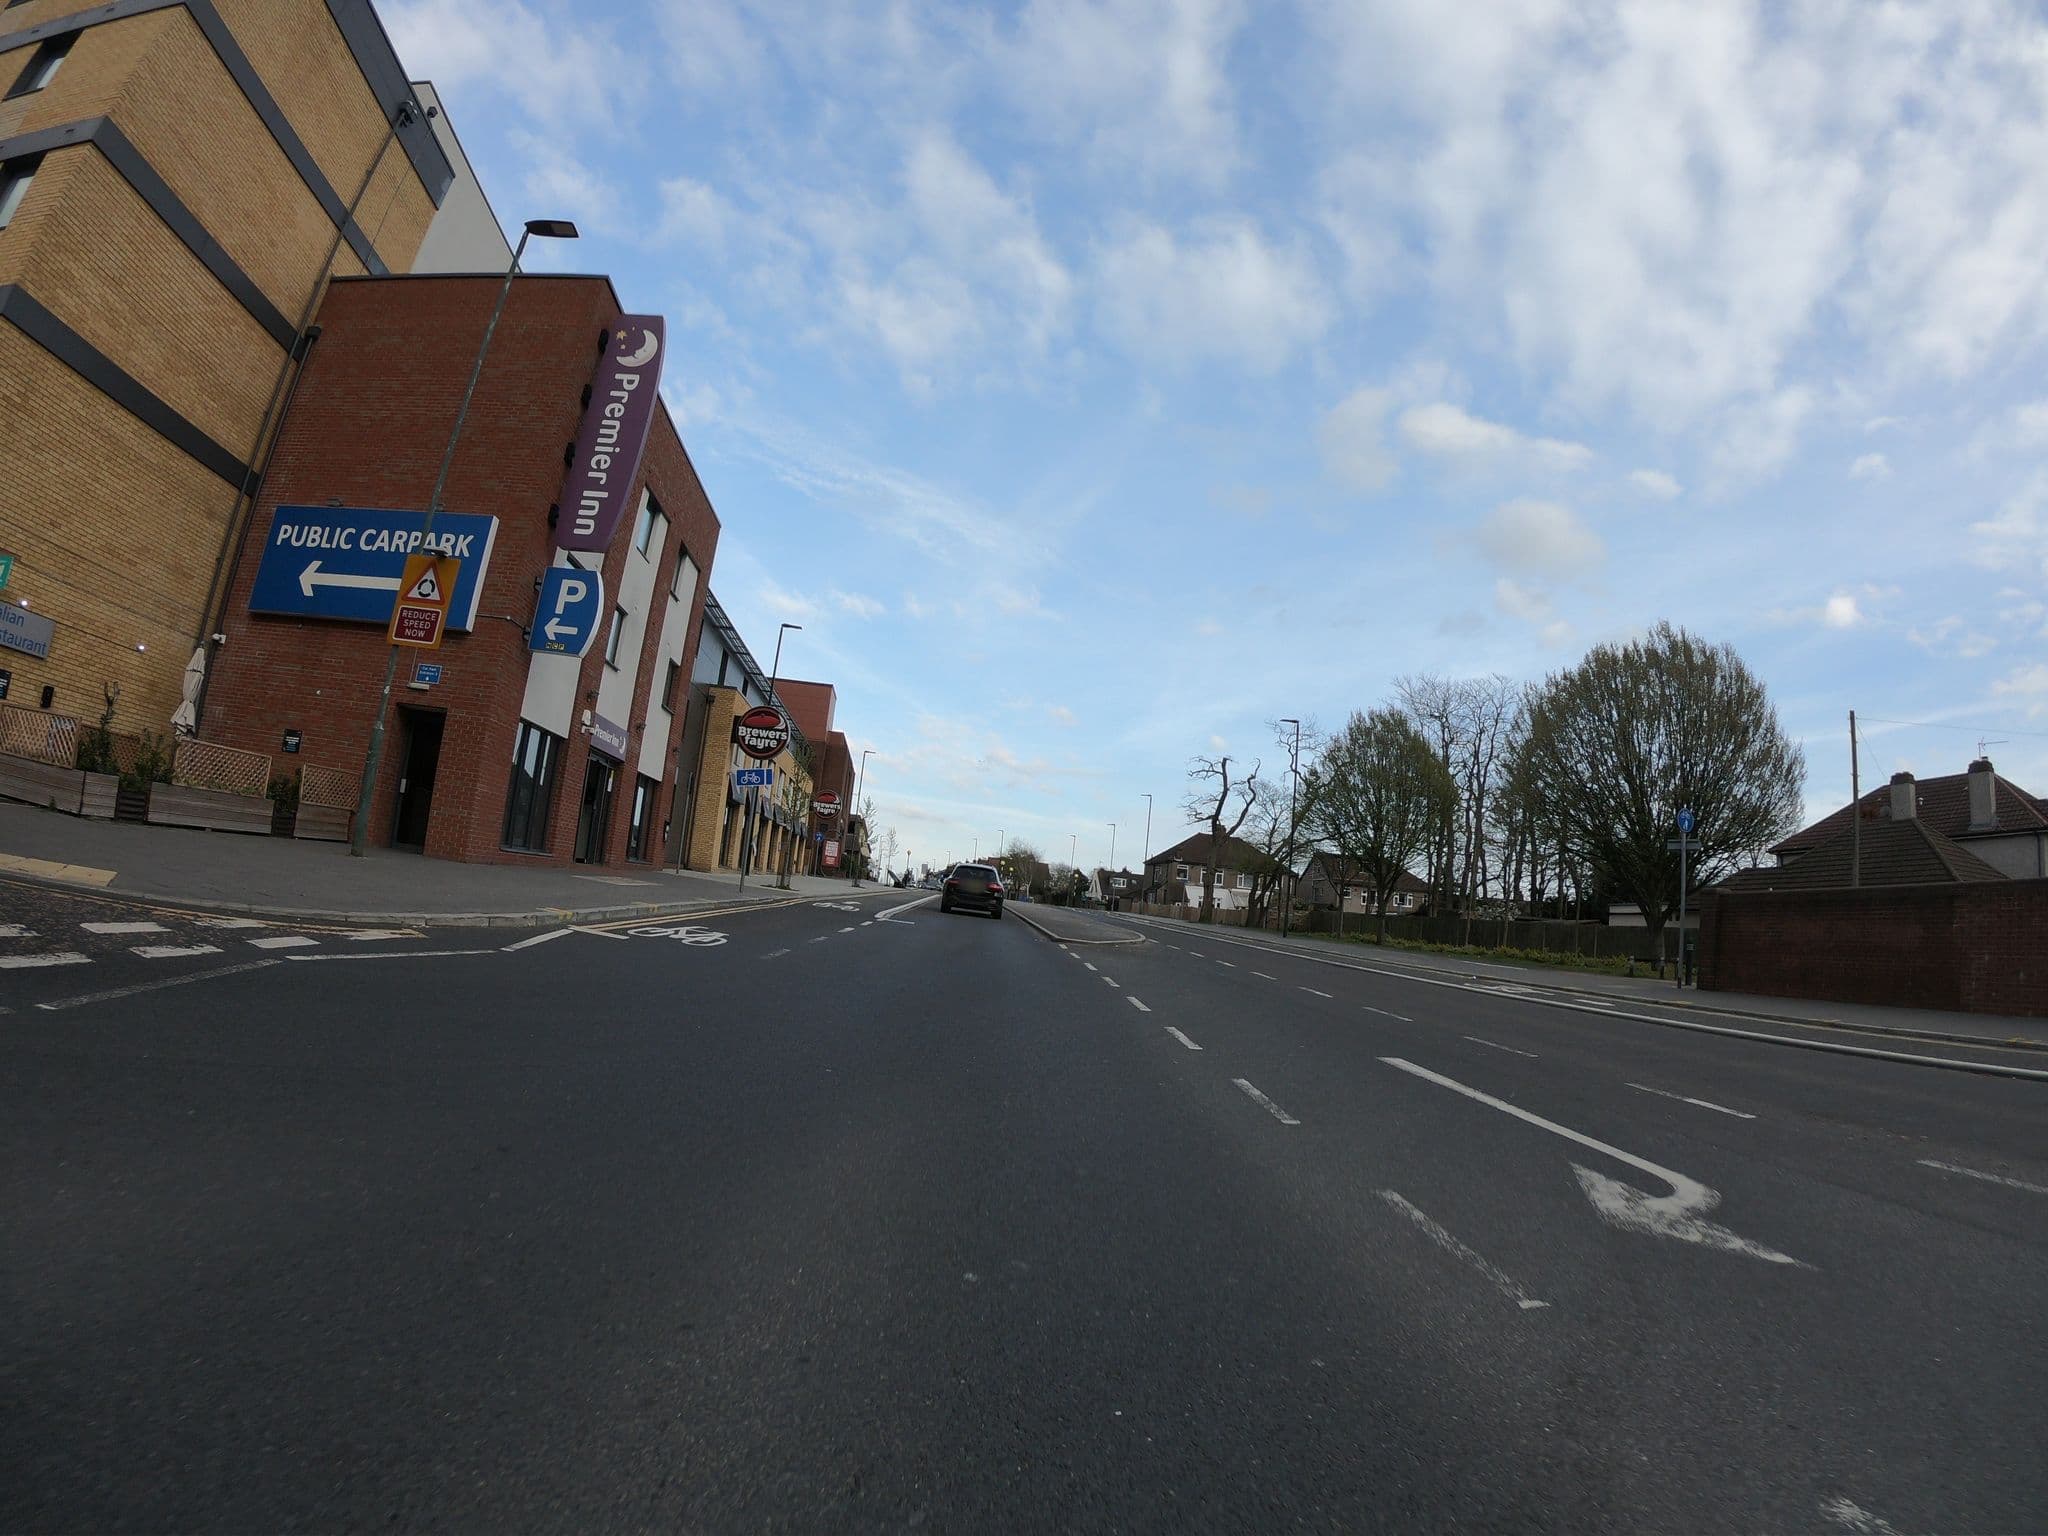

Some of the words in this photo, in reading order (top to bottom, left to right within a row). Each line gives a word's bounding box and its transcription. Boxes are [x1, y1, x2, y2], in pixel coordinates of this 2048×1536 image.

[587, 373, 640, 485] Premier
[573, 490, 609, 536] Inn
[276, 524, 356, 550] PUBLIC
[359, 528, 475, 558] CARPARK
[555, 579, 587, 614] P
[402, 609, 437, 621] REDUCE
[403, 619, 431, 629] SPEED
[405, 628, 426, 638] NOW
[738, 726, 788, 740] Brewers
[744, 735, 778, 749] fayre
[812, 801, 841, 810] Brewers
